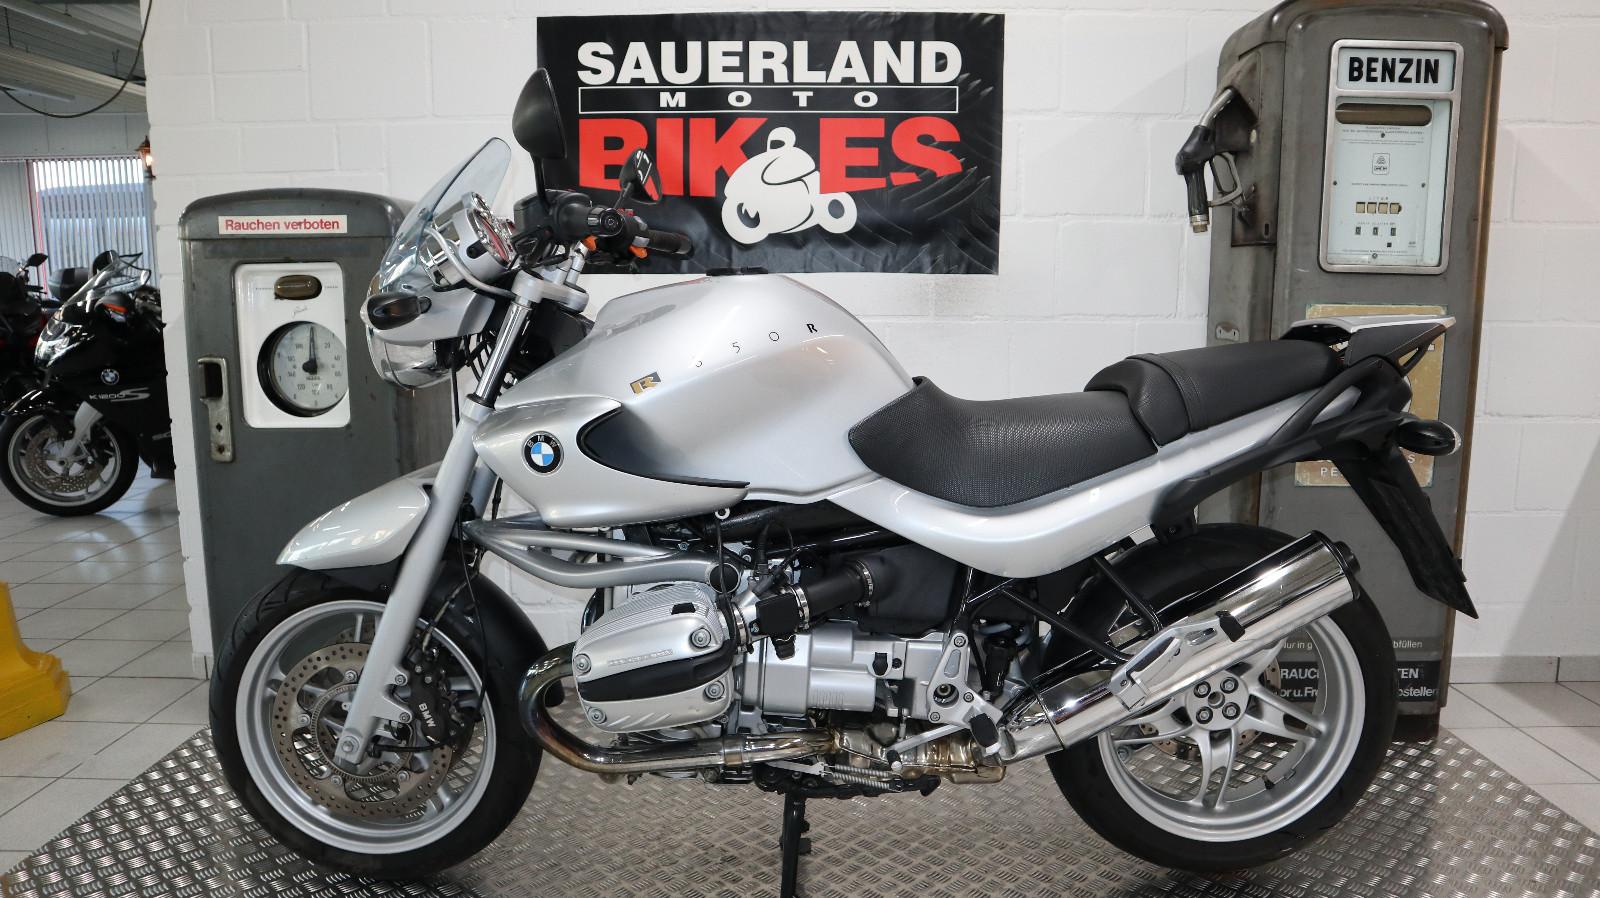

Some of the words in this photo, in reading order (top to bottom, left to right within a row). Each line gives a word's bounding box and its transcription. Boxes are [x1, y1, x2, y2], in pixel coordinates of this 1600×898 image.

[577, 40, 963, 85] SAUERLAND
[1348, 56, 1440, 84] BENZIN
[659, 91, 878, 108] MOTO
[225, 219, 280, 231] Rauchen
[284, 218, 340, 230] verboten
[1393, 639, 1423, 649] bfüllen
[419, 702, 436, 727] BMW
